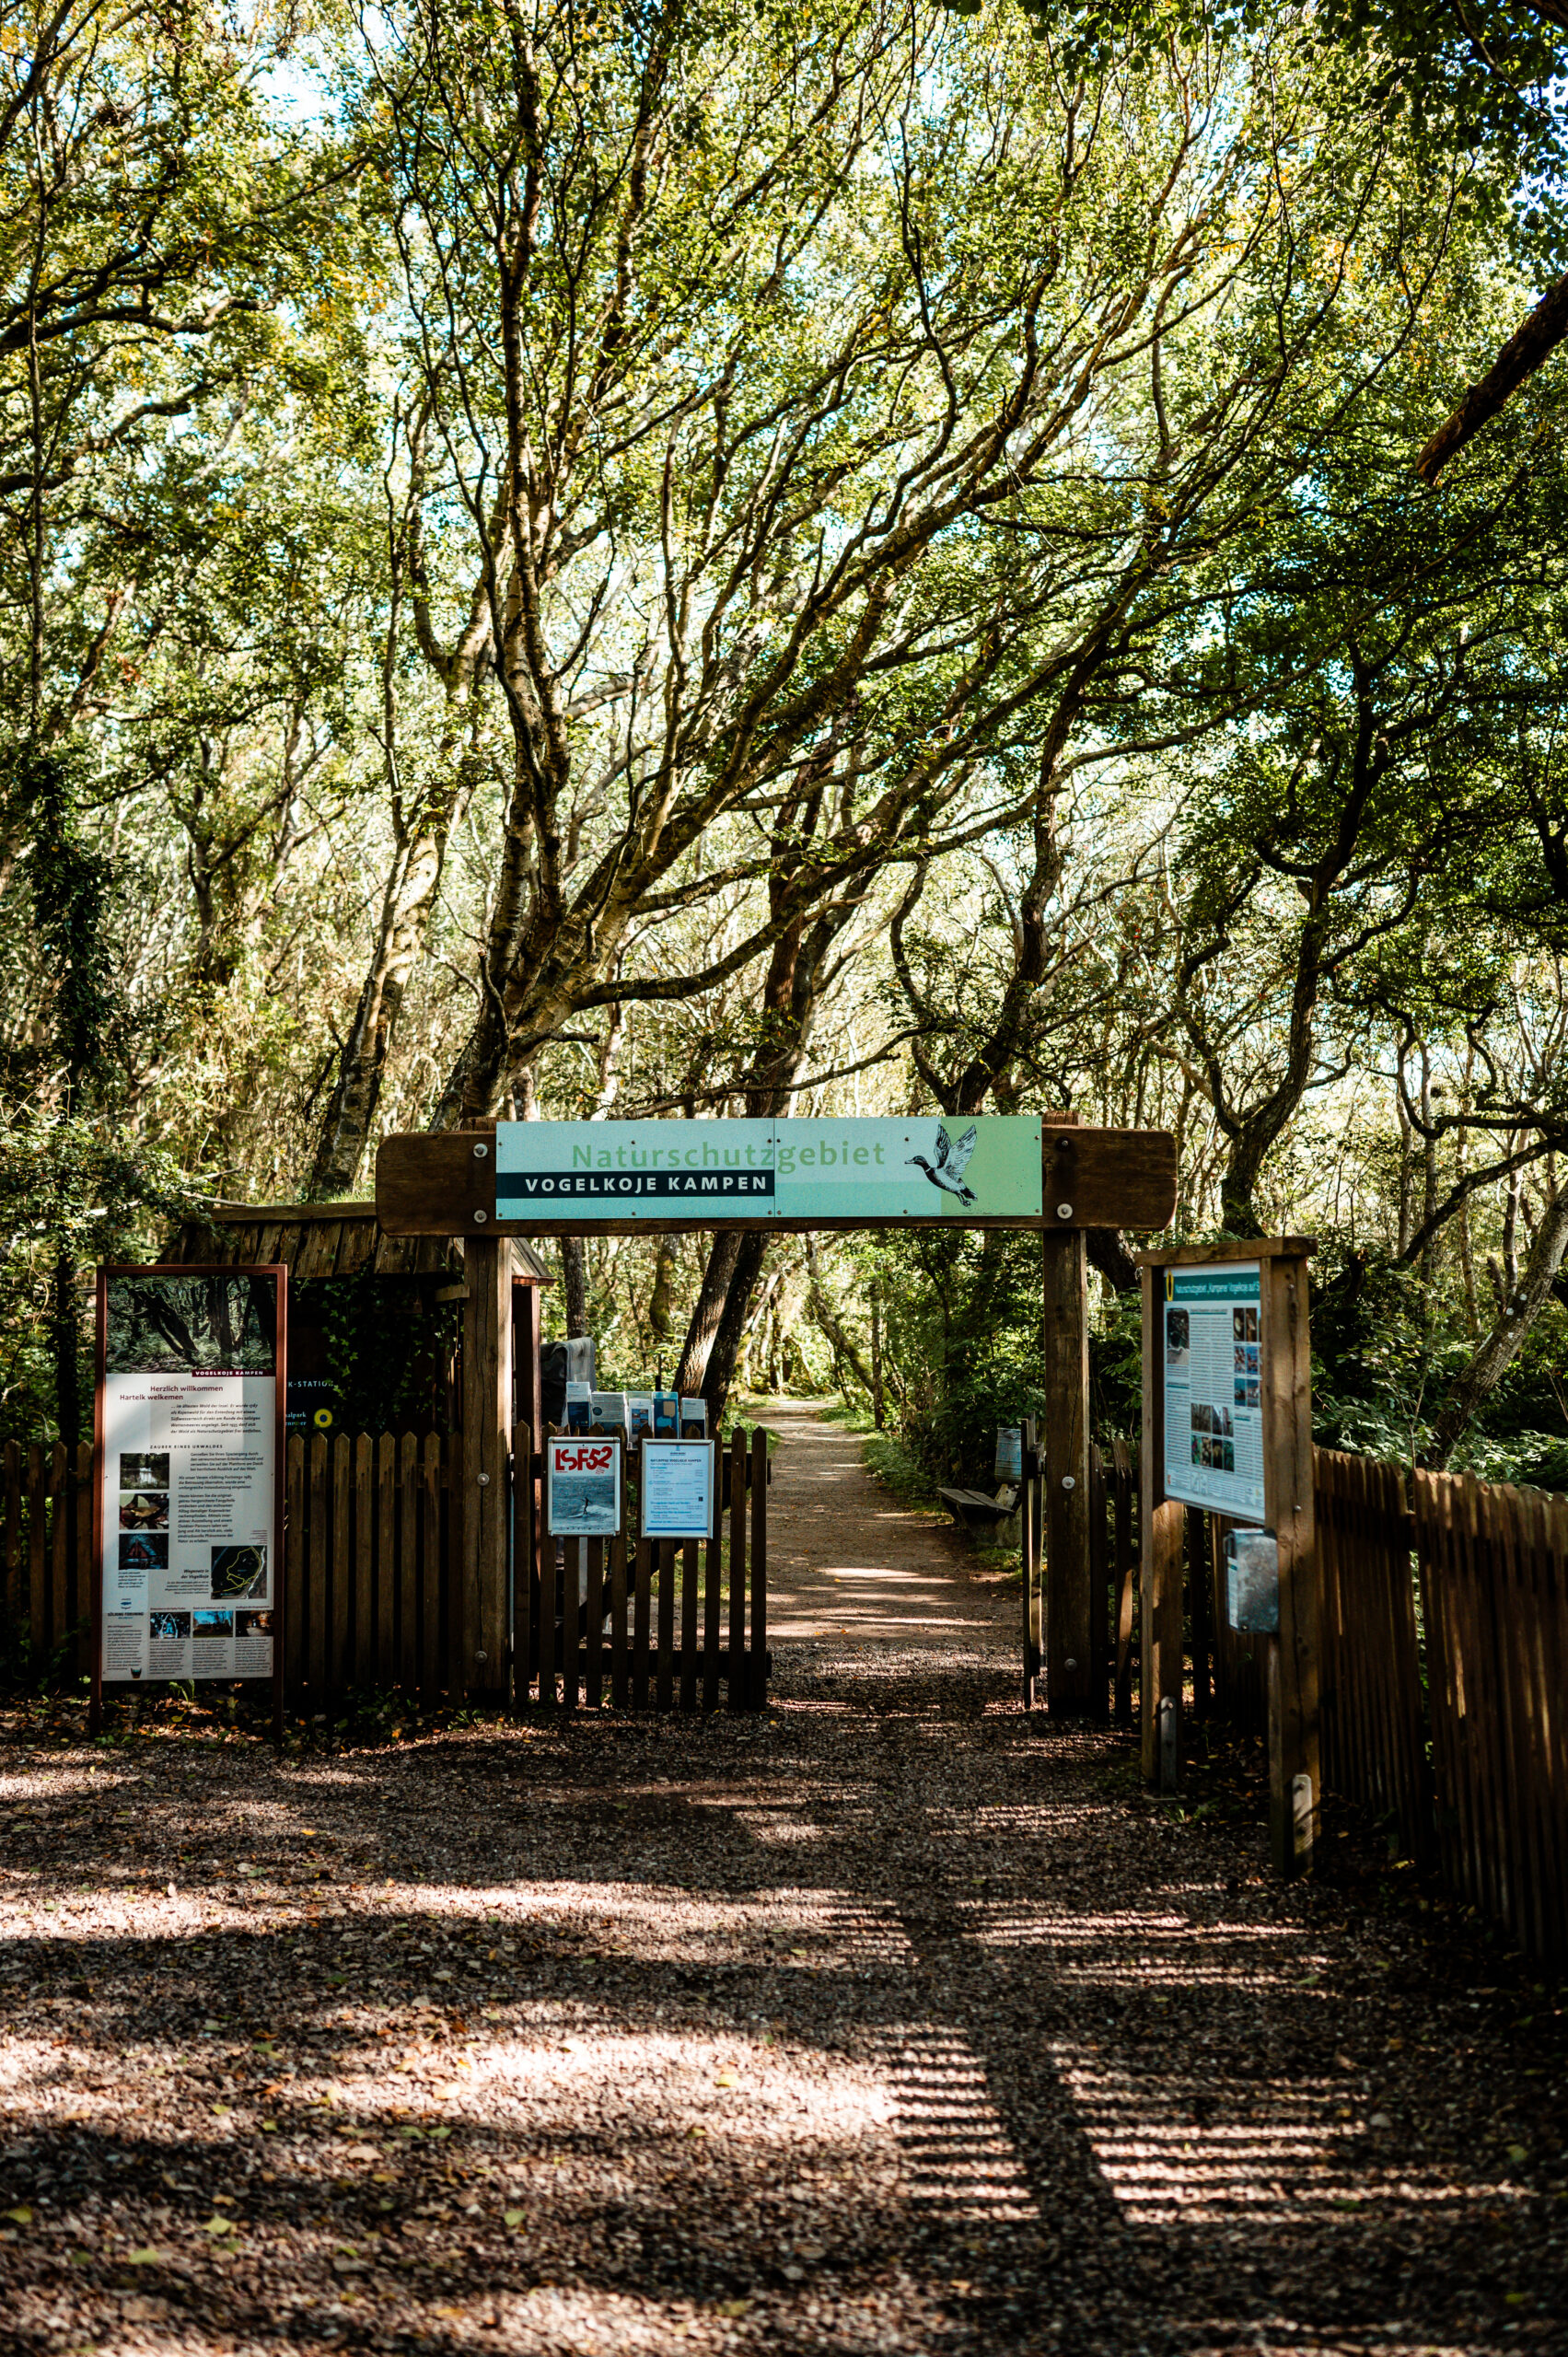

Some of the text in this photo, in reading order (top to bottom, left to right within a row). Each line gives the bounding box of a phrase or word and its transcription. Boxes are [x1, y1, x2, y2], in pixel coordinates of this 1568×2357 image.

[573, 1141, 885, 1176] Naturschutzgebiet
[525, 1174, 766, 1195] VOGELKOJE KAMPEN
[555, 1446, 613, 1471] LSF52
